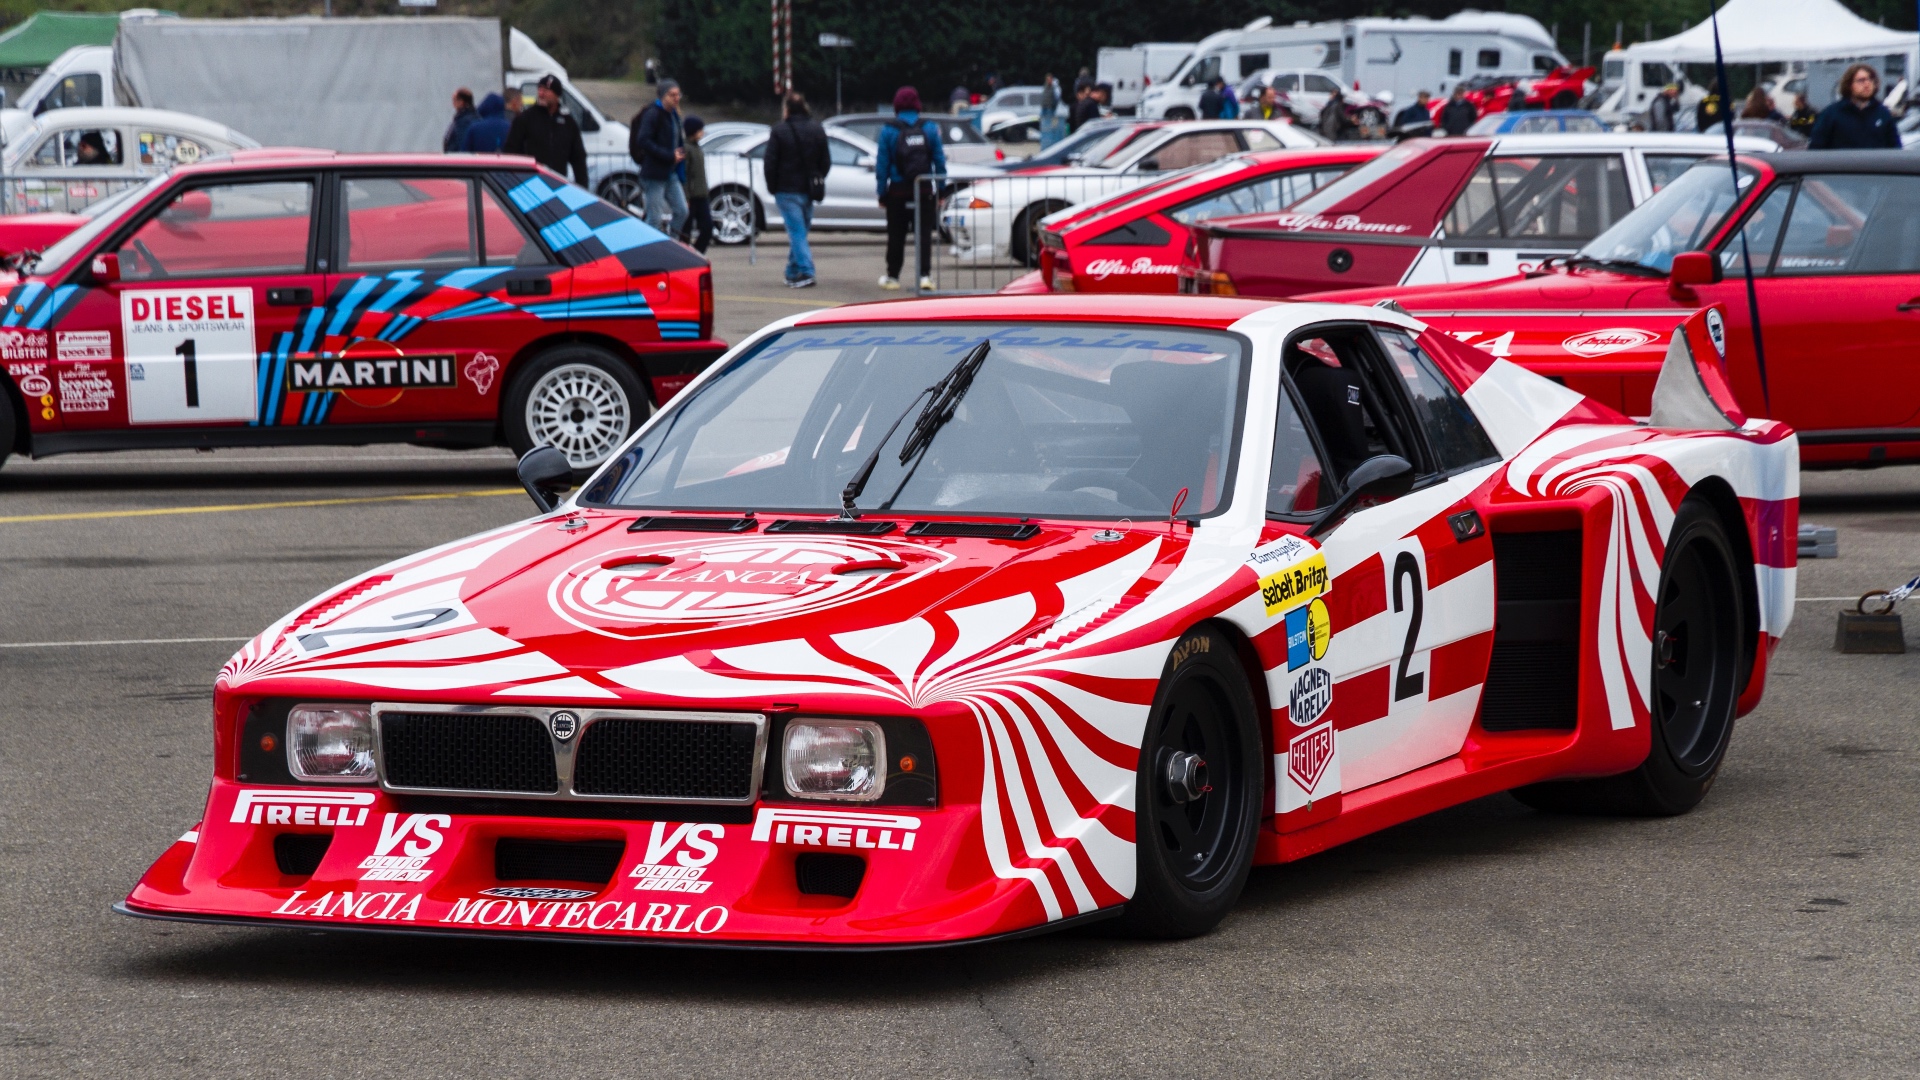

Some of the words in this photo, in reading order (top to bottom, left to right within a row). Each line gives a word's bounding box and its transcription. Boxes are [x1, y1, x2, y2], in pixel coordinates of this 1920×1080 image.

[1278, 214, 1333, 232] Alfa
[1333, 214, 1412, 233] Romeo
[1085, 258, 1130, 281] Alfa
[131, 295, 244, 321] DIESEL
[132, 323, 163, 334] JEANS
[167, 323, 175, 333] &
[178, 321, 245, 333] SPORTSWEAR
[2, 346, 48, 360] BILSTEIN
[9, 363, 47, 376] SKF
[175, 338, 199, 408] 1
[293, 358, 450, 388] MARTINI
[24, 381, 48, 392] Esso
[59, 377, 113, 392] brembo
[60, 390, 84, 401] TRW
[86, 388, 116, 400] Sabelt
[63, 401, 106, 410] FERODO
[647, 567, 813, 585] LANCIA
[1262, 572, 1296, 607] sabelt
[1294, 565, 1329, 595] Britax
[296, 607, 459, 652] 2
[1392, 551, 1425, 702] 2
[1287, 630, 1307, 649] BILSTEIN
[1173, 636, 1210, 671] AVON
[1290, 668, 1331, 701] MAGNETI
[1290, 689, 1331, 723] MARELLI
[1293, 733, 1329, 780] HEUER
[229, 789, 376, 826] PIRELLI
[373, 812, 452, 857] VS
[750, 807, 922, 851] PIRELLI
[643, 821, 725, 868] VS
[361, 856, 427, 869] OLIO
[632, 865, 704, 879] OLIO
[363, 869, 431, 881] FIAT
[638, 878, 711, 892] FIAT
[271, 890, 423, 921] LANCIA
[439, 896, 729, 934] MONTECARLO
